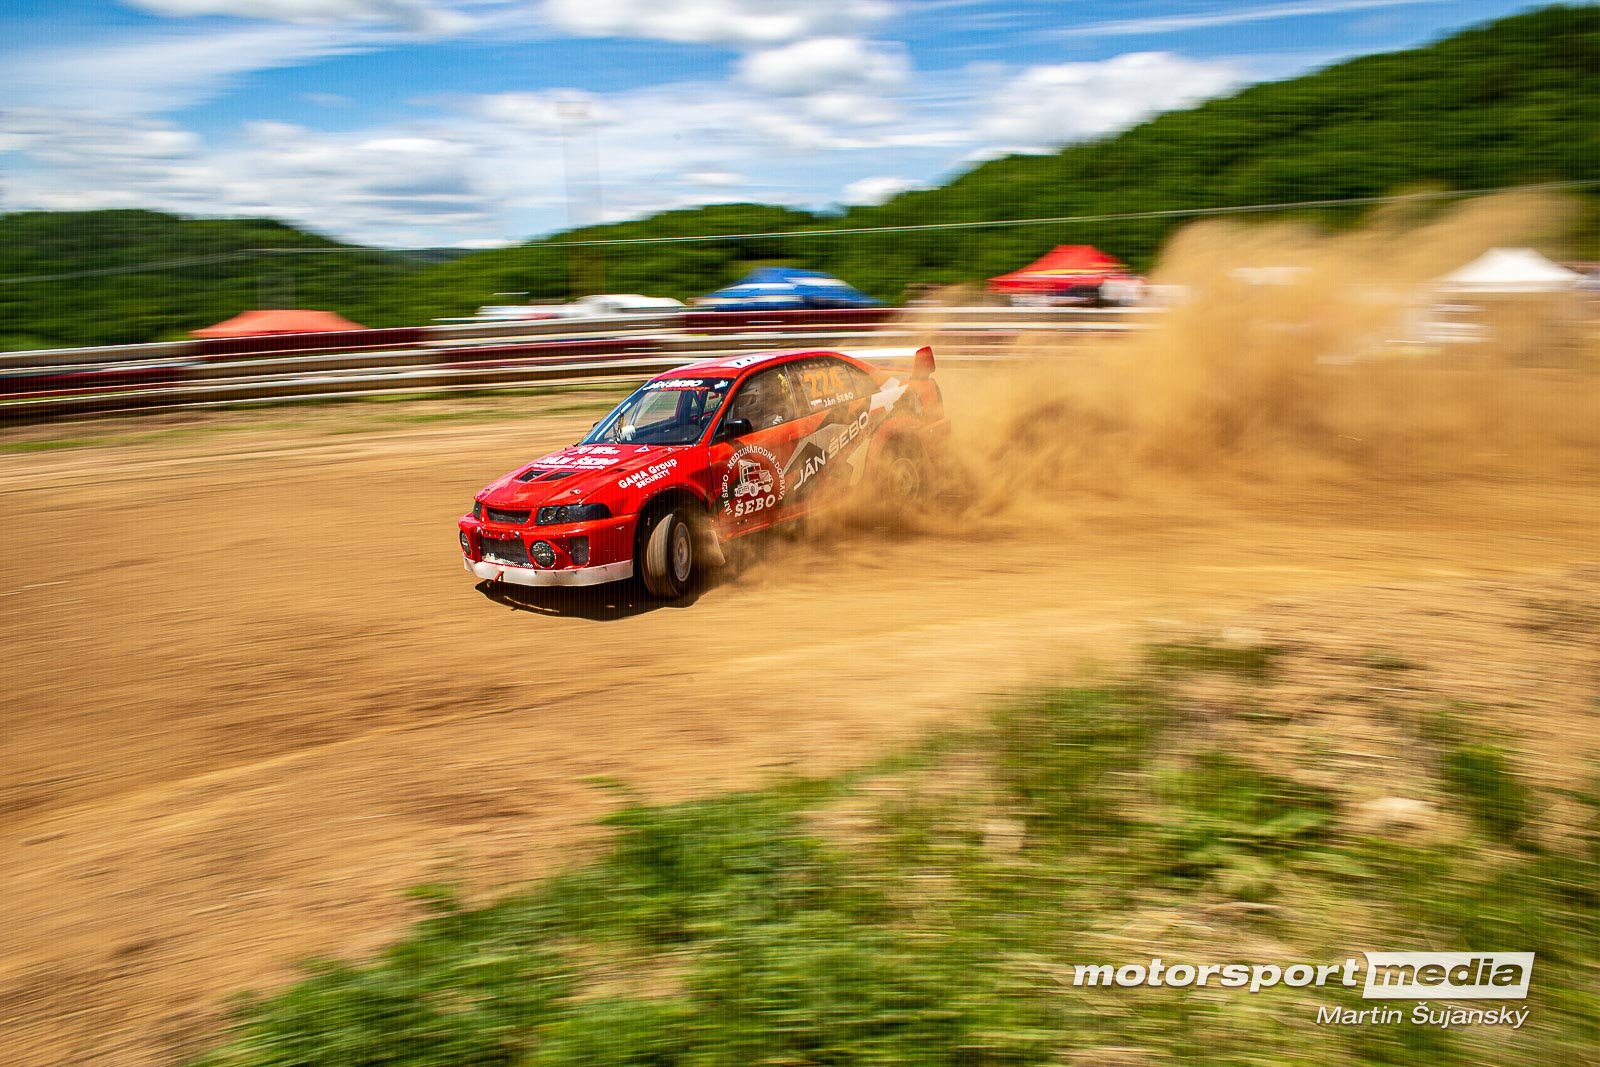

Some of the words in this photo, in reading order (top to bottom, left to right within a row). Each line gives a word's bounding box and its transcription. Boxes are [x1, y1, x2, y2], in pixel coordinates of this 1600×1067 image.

[793, 449, 826, 491] JÁN
[828, 411, 869, 459] ŠEBO
[618, 470, 649, 489] GAMA
[648, 458, 678, 475] Group
[635, 469, 671, 489] SECURITY
[734, 494, 776, 518] ŠEBO
